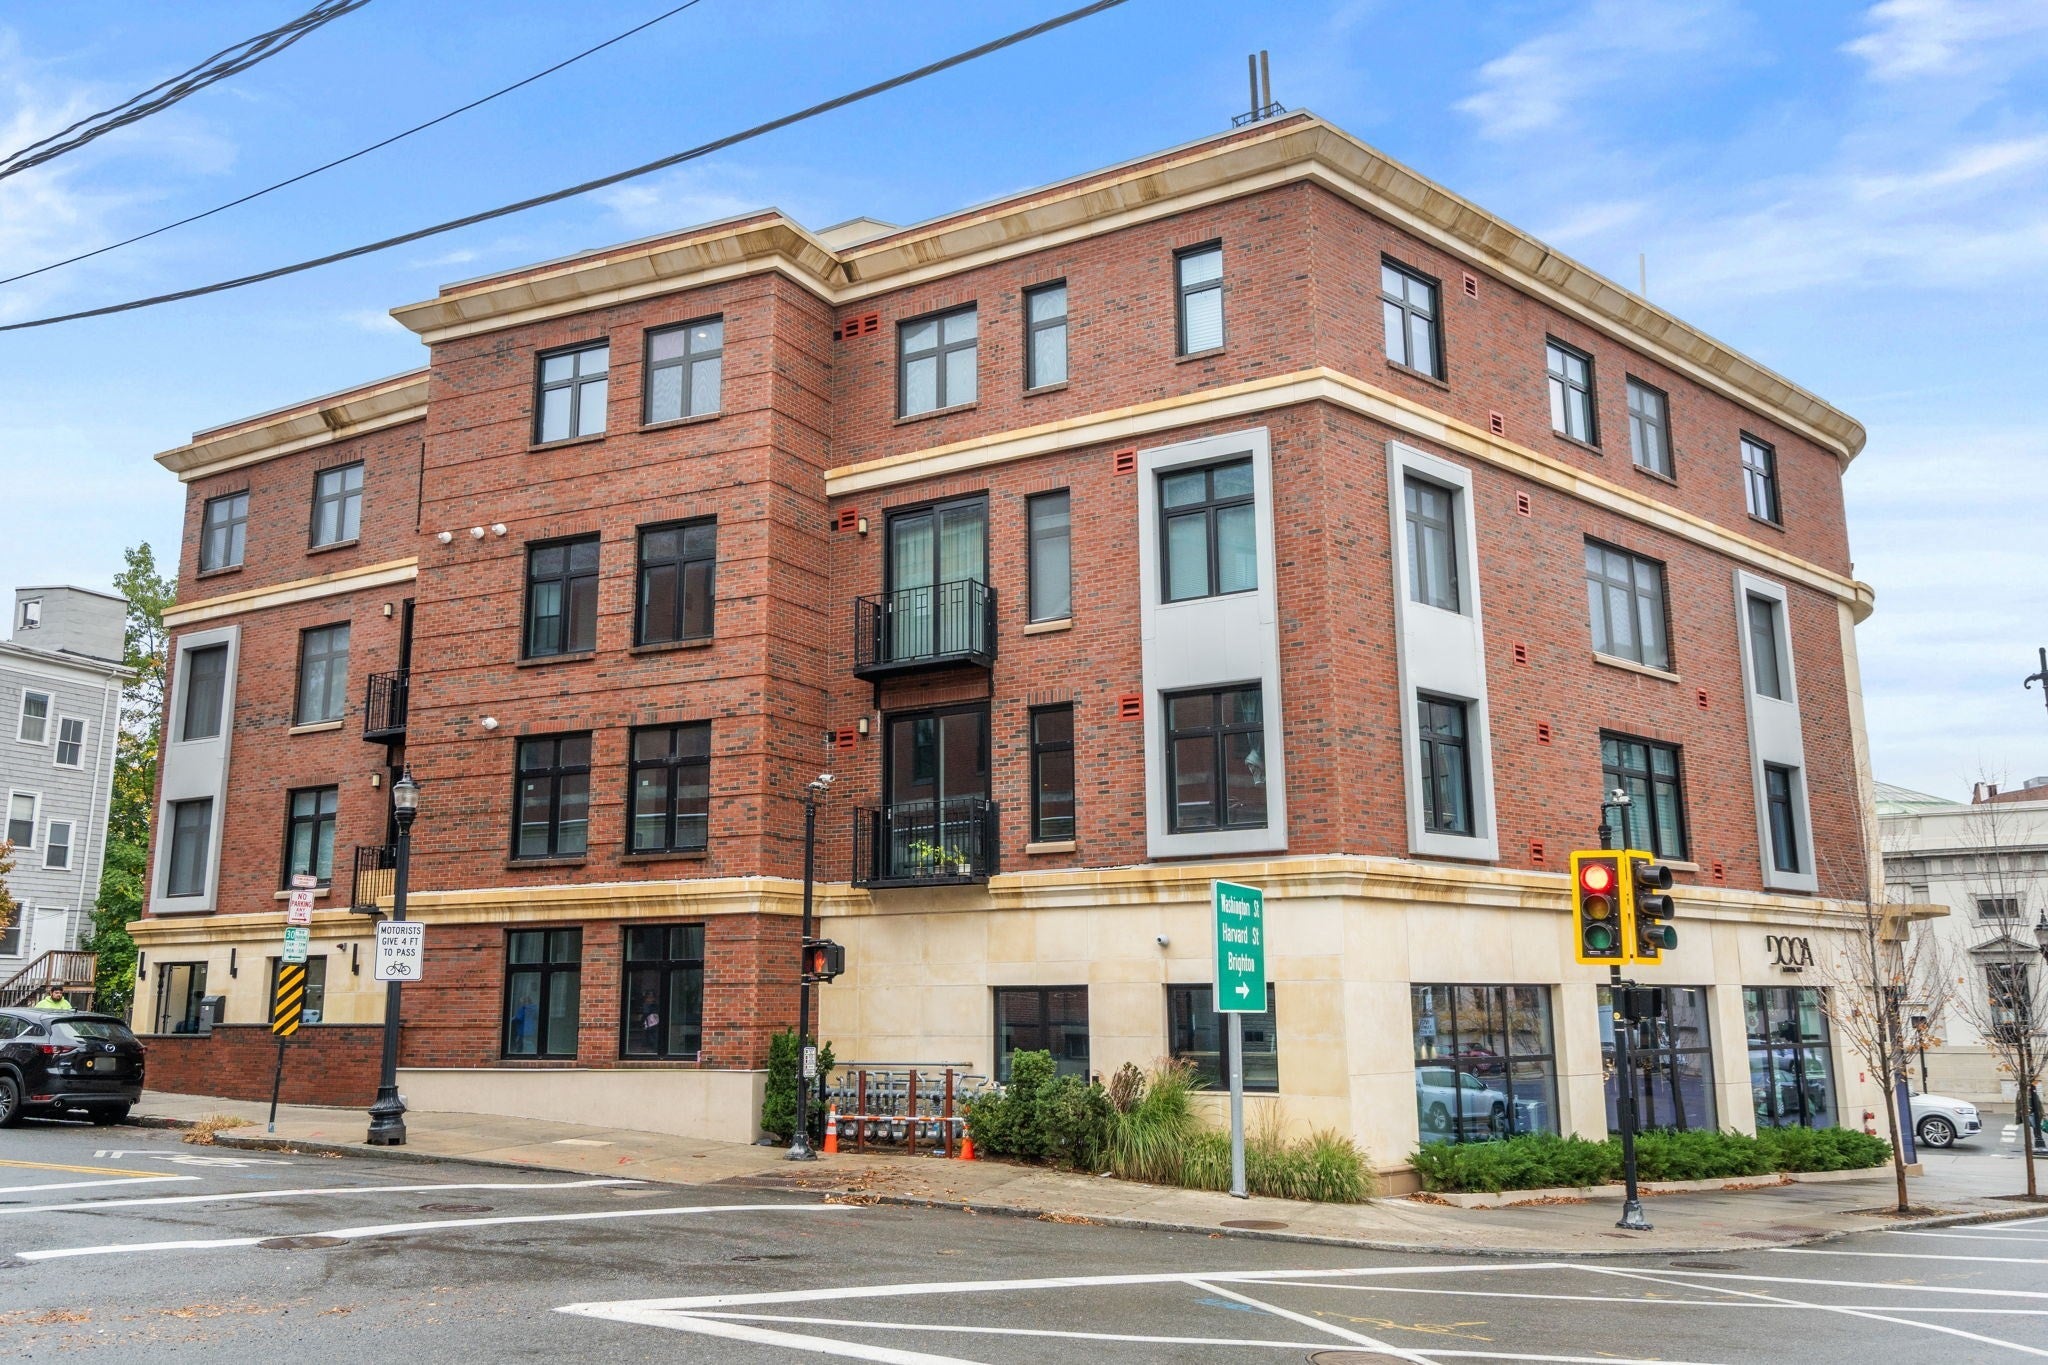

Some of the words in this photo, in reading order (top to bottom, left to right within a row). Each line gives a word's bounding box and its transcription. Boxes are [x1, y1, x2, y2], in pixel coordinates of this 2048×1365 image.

[1220, 893, 1251, 920] Washington
[1253, 899, 1260, 918] St
[286, 930, 295, 939] 30
[380, 926, 421, 935] MOTORISTS
[1222, 922, 1248, 944] Harvard
[1252, 926, 1260, 946] St
[382, 937, 398, 946] GIVE
[401, 937, 407, 946] 4
[409, 937, 419, 946] FT
[384, 948, 393, 957] TO
[396, 948, 416, 957] PASS
[1228, 951, 1255, 977] Brighton
